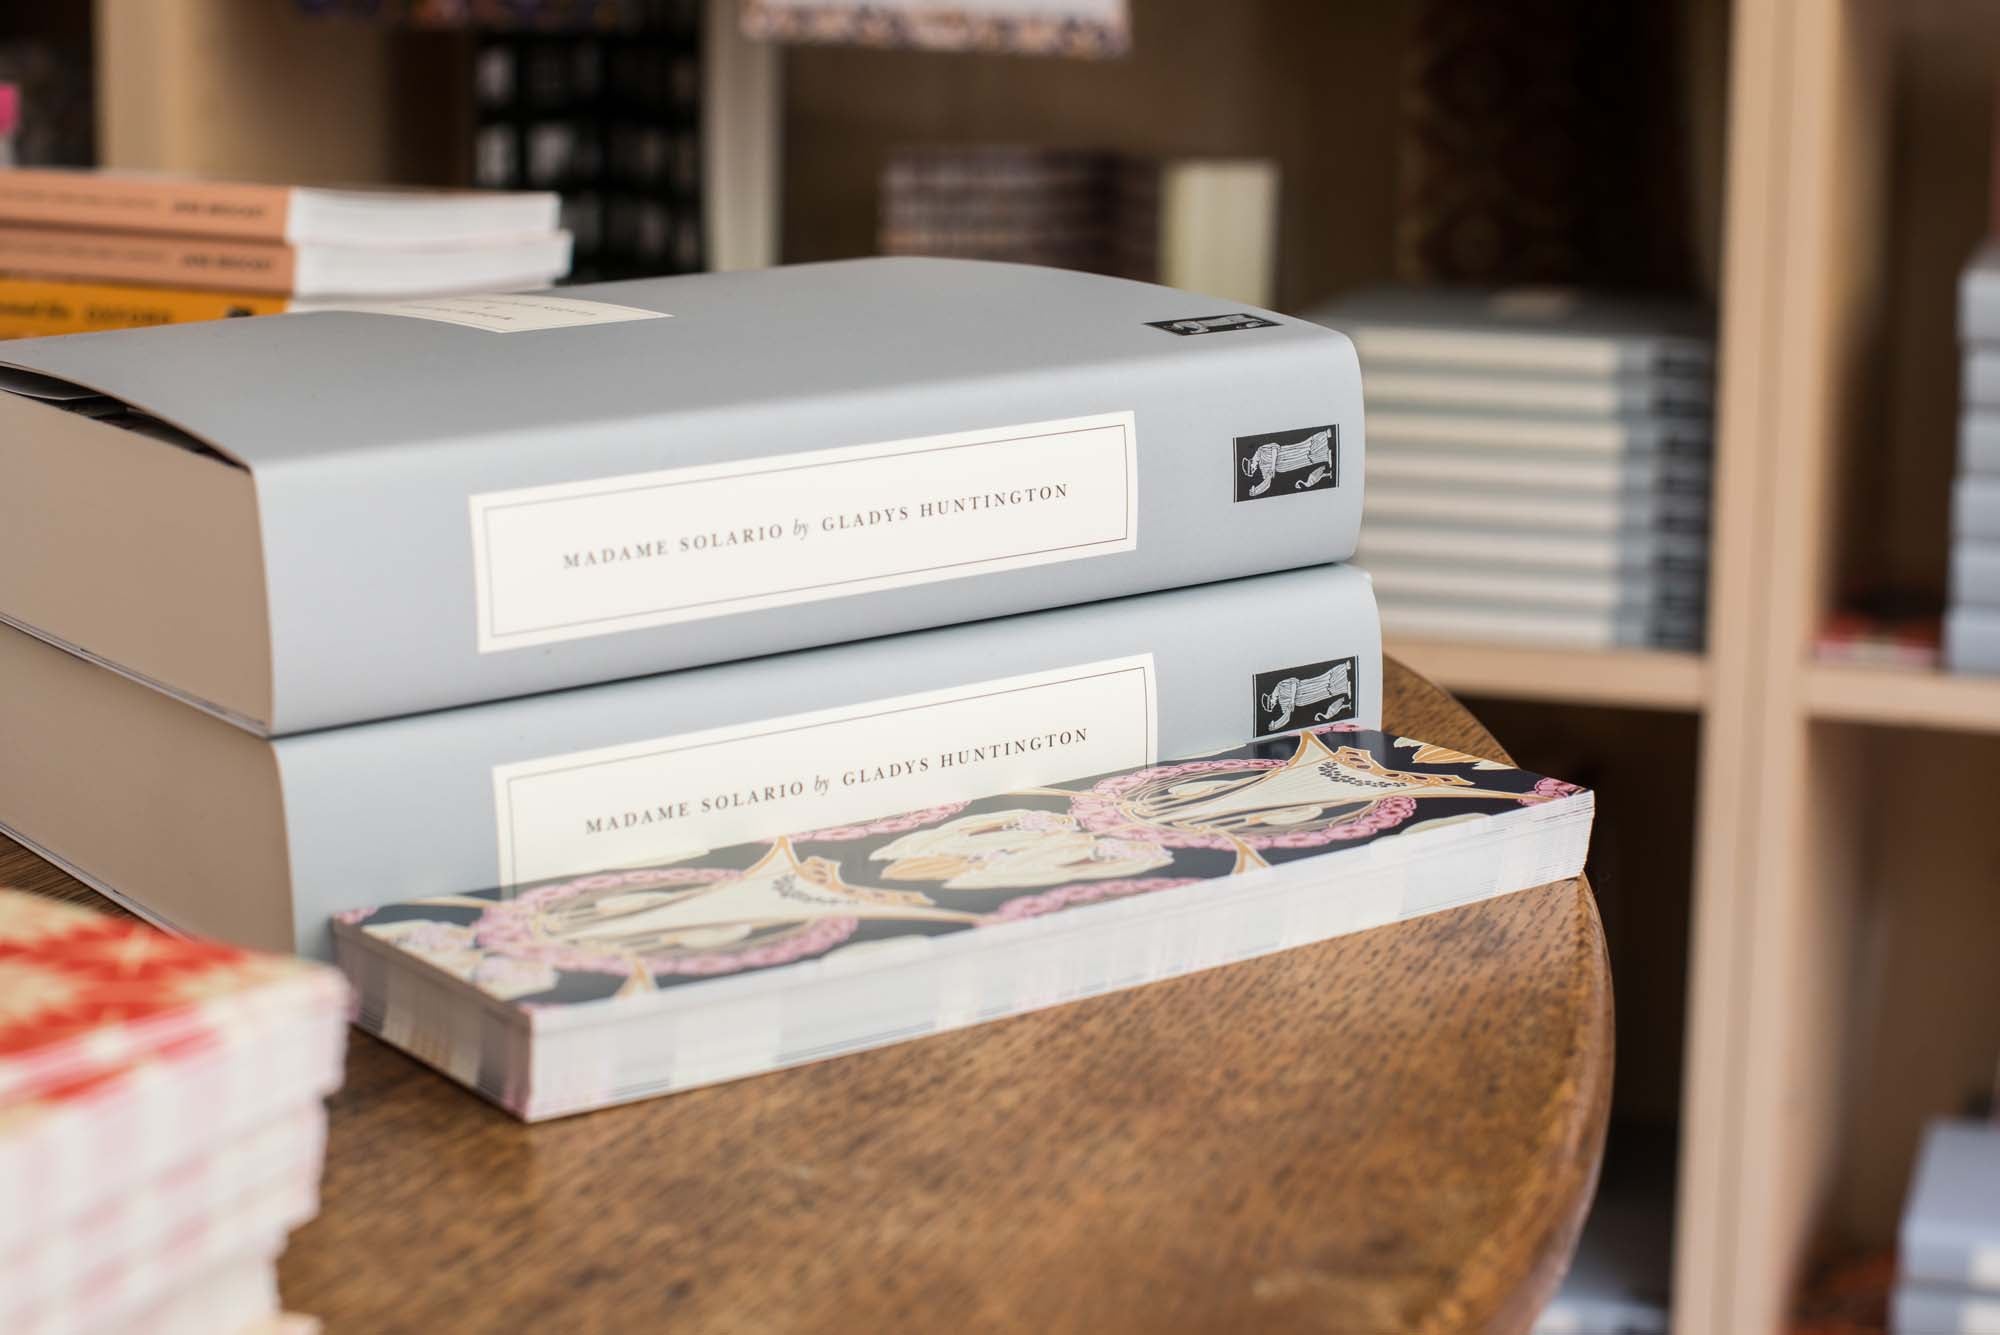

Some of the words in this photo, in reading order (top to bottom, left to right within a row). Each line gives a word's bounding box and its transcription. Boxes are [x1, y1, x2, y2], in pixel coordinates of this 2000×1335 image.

[563, 537, 669, 570] MADAME
[679, 523, 784, 552] SOLARIO
[793, 518, 809, 542] by
[821, 506, 910, 533] GLADYS
[919, 482, 1069, 518] HUNTINGTON
[585, 801, 690, 836] MADAME
[701, 780, 804, 813] SOLARIO
[813, 774, 830, 798] by
[842, 757, 930, 788] GLADYS
[940, 727, 1089, 769] HUNTINGTON
